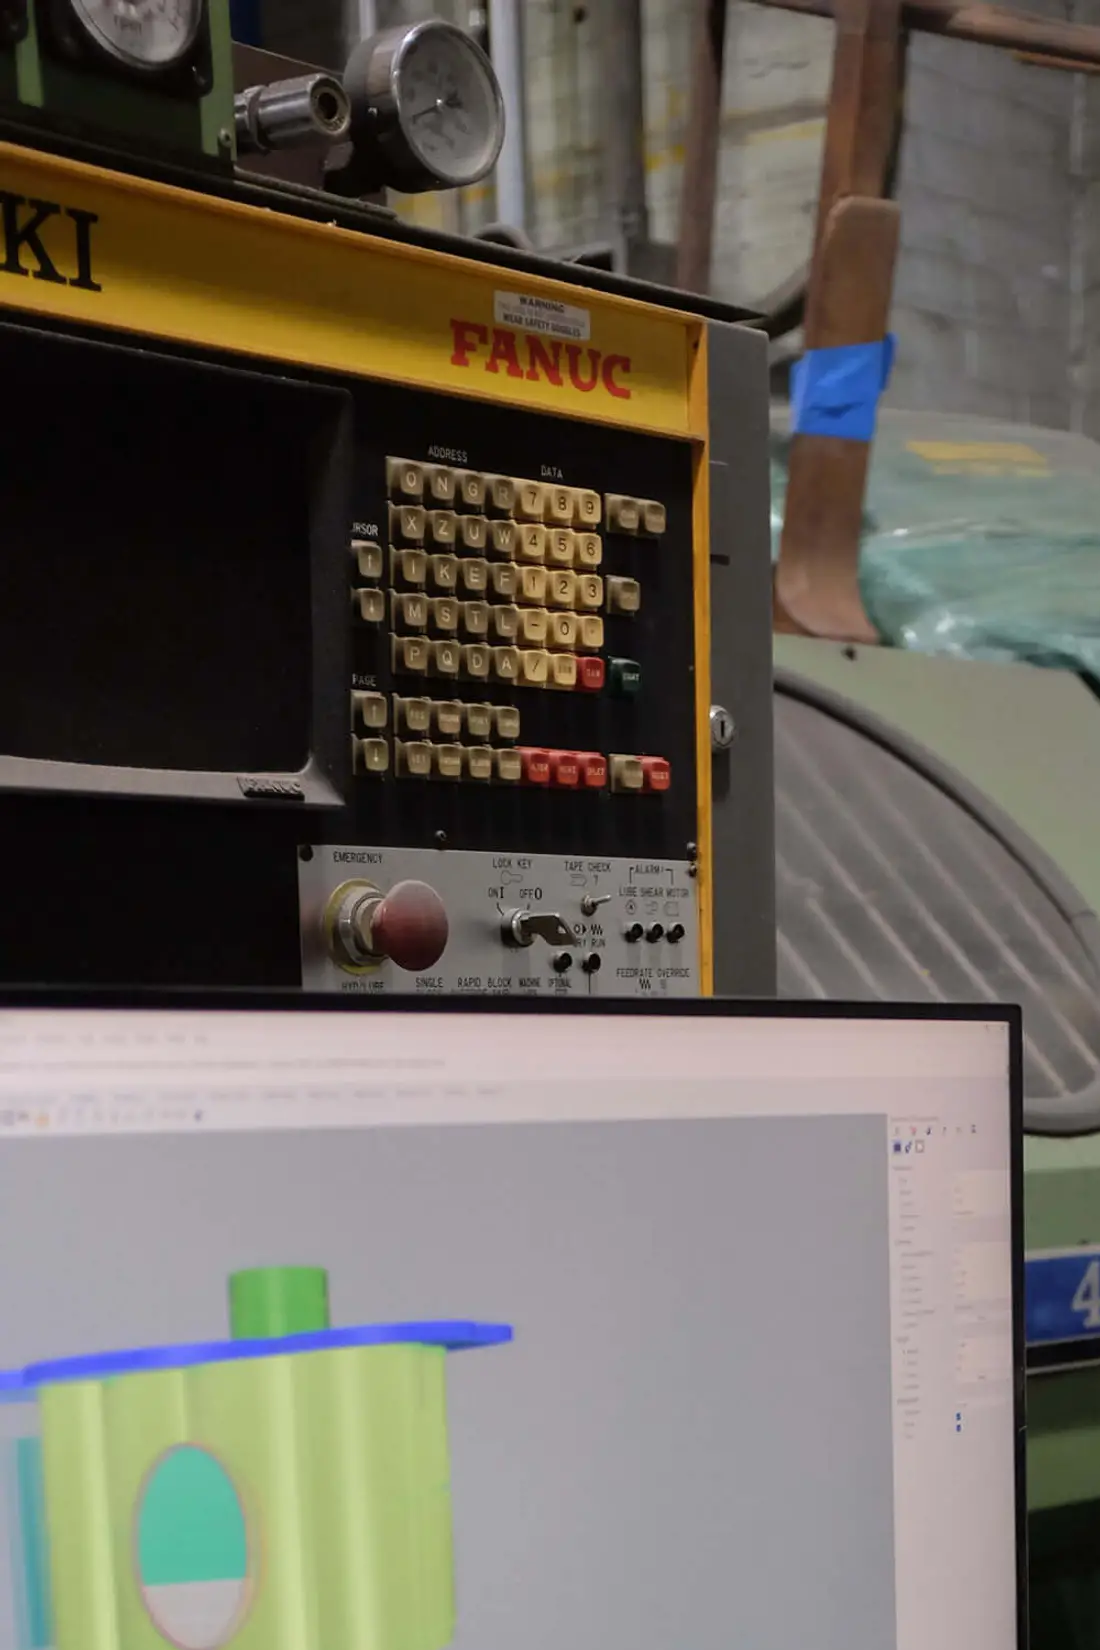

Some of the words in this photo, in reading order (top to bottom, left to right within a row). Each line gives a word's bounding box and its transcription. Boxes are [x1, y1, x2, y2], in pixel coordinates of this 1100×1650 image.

[519, 296, 565, 313] WARNING
[450, 318, 632, 400] FANUC
[428, 445, 468, 463] ADDRESS
[541, 465, 563, 478] DATA
[437, 477, 447, 492] N
[468, 483, 478, 496] G
[528, 491, 537, 506] 7
[558, 496, 566, 510] 8
[407, 516, 416, 531] X
[439, 520, 449, 535] Z
[469, 526, 479, 539] U
[499, 530, 511, 544] W
[528, 534, 537, 546] 4
[558, 538, 567, 551] 5
[587, 543, 595, 556] 6
[439, 565, 449, 580] K
[469, 568, 480, 582] E
[500, 573, 510, 586] F
[559, 581, 568, 594] 2
[589, 584, 597, 597] 3
[408, 603, 421, 618] M
[441, 607, 450, 622] S
[471, 611, 481, 624] T
[501, 616, 511, 629] L
[410, 649, 420, 661] P
[442, 651, 452, 665] Q
[472, 655, 483, 668] D
[501, 659, 512, 670] A
[333, 851, 382, 864] EMERGENCY
[493, 859, 512, 869] LOCK
[517, 859, 532, 869] KEY
[565, 861, 584, 871] TAPE
[588, 862, 612, 872] CHECK
[635, 865, 660, 874] ALARM
[519, 888, 533, 898] OFF
[619, 887, 637, 897] LUBE
[640, 887, 663, 898] SHEAR
[666, 888, 689, 898] MOTOR
[591, 939, 606, 947] RUN
[616, 968, 653, 978] FEEDRATE
[656, 968, 690, 978] OVERRIDE
[415, 977, 444, 988] SINGLE
[457, 977, 481, 988] RAPID
[487, 977, 512, 988] BLOCK
